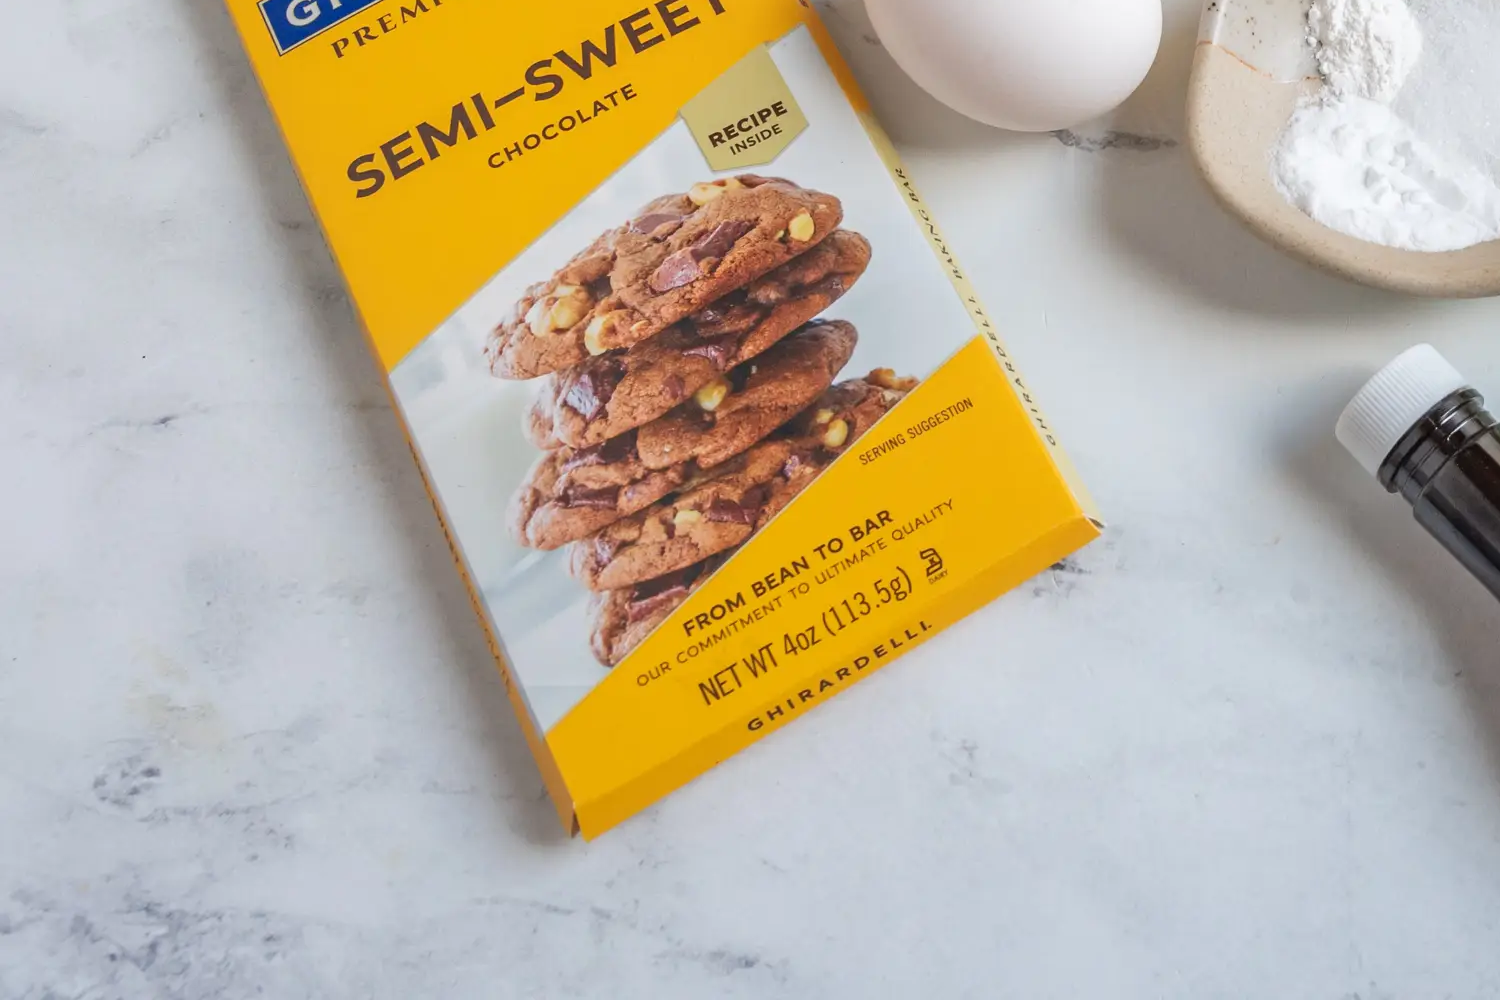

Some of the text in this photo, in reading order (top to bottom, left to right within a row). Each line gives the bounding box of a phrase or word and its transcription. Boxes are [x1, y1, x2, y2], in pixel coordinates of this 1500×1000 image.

[487, 84, 638, 169] CHOCOLATE
[707, 101, 788, 148] RECIPE
[729, 124, 783, 157] INSIDE
[895, 167, 919, 202] BAR
[917, 209, 963, 280] BAKING
[858, 398, 974, 466] SERVING SUGGESTION
[636, 498, 955, 688] OUR COMMITMENT TO ULTIMATE QUALITY
[682, 509, 894, 637] FROM BEAN TO BAR
[698, 565, 914, 706] NET WT 4oz (113.5g)
[747, 620, 929, 732] GHIRARDELLI
